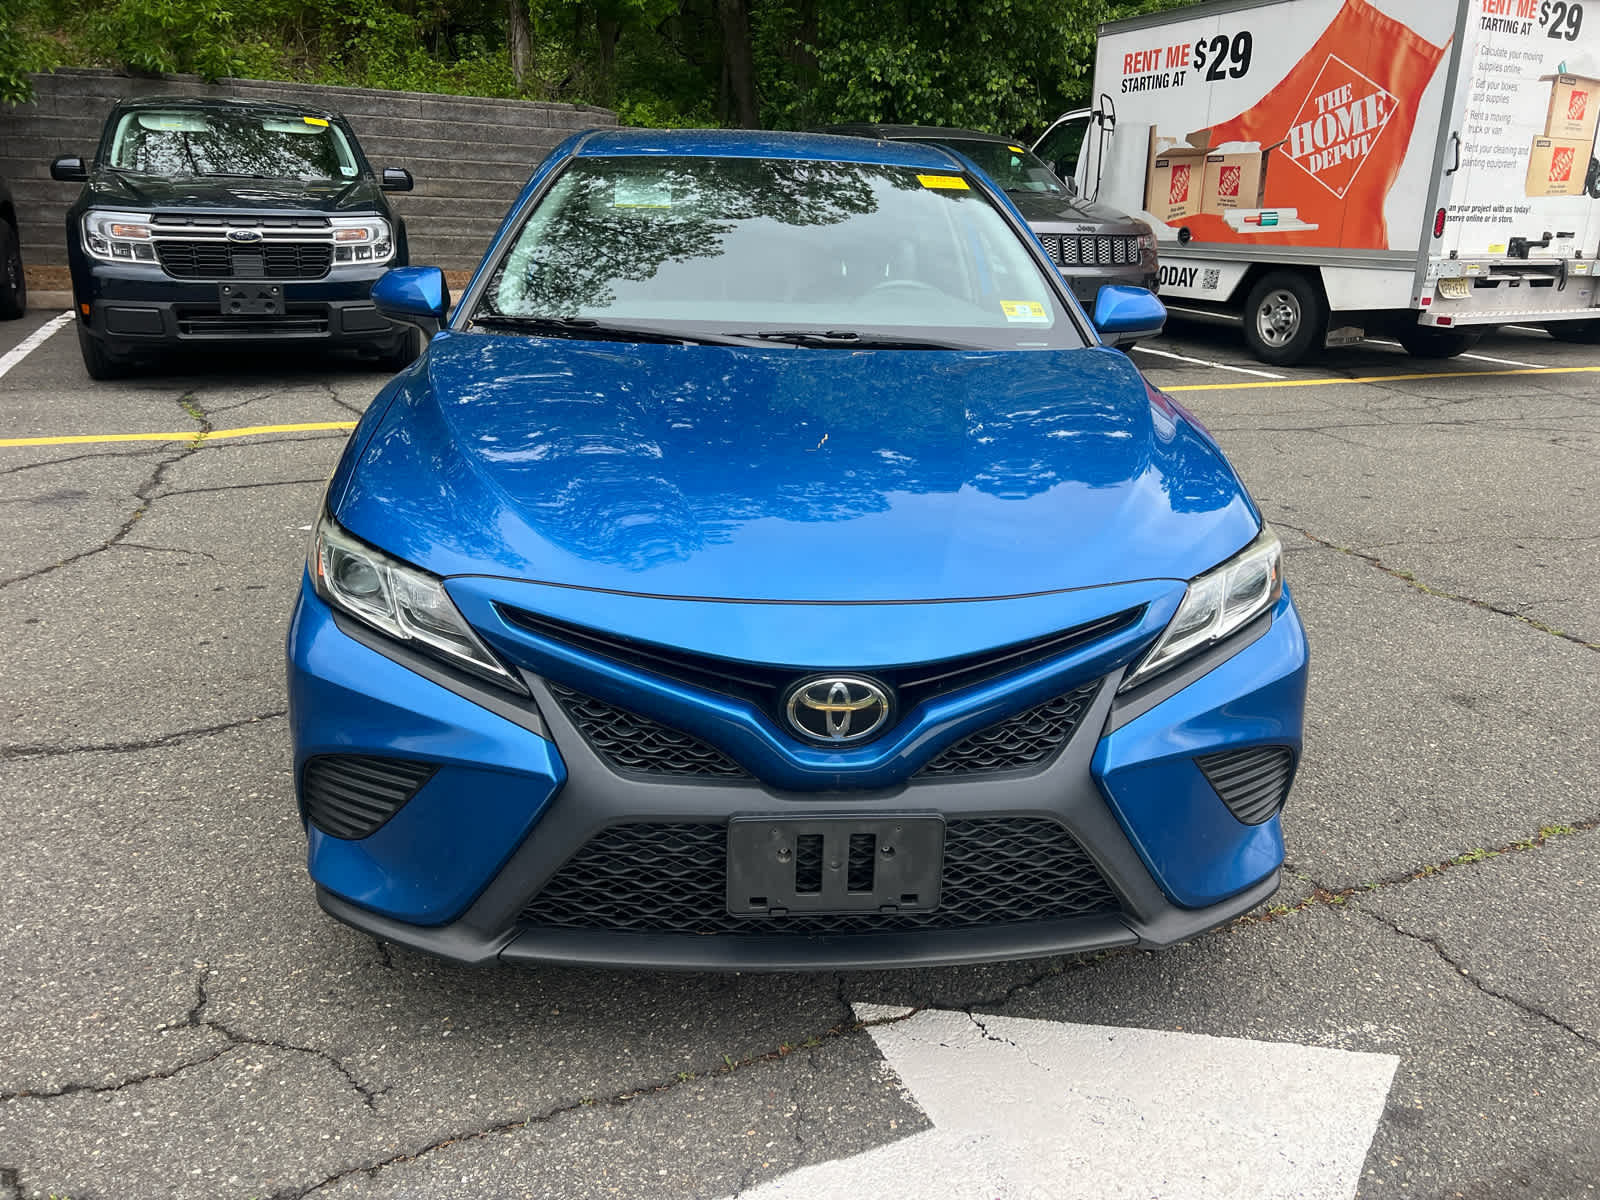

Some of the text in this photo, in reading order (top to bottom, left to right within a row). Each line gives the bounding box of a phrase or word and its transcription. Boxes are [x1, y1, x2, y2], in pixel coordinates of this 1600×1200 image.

[1517, 0, 1537, 19] ME
[1480, 16, 1533, 36] TARTING AT
[1538, 0, 1583, 41] $29
[1123, 43, 1191, 75] RENT ME
[1193, 31, 1253, 82] $29
[1481, 45, 1544, 64] Calculate your moving
[1479, 62, 1503, 73] supplies
[1121, 71, 1186, 93] STARTING AT
[1475, 78, 1486, 89] Get
[1487, 82, 1500, 91] your
[1315, 83, 1353, 114] THE
[1290, 90, 1389, 159] HOME
[1470, 110, 1484, 121] Rent
[1490, 113, 1511, 125] moving
[1309, 133, 1372, 174] DEPOT
[1480, 145, 1493, 154] your
[1462, 157, 1486, 170] painting
[1457, 205, 1470, 213] your
[1471, 205, 1491, 214] project
[1465, 214, 1483, 222] online
[1492, 214, 1498, 222] in
[1076, 224, 1096, 233] Jeep
[1159, 265, 1198, 287] ODAY
